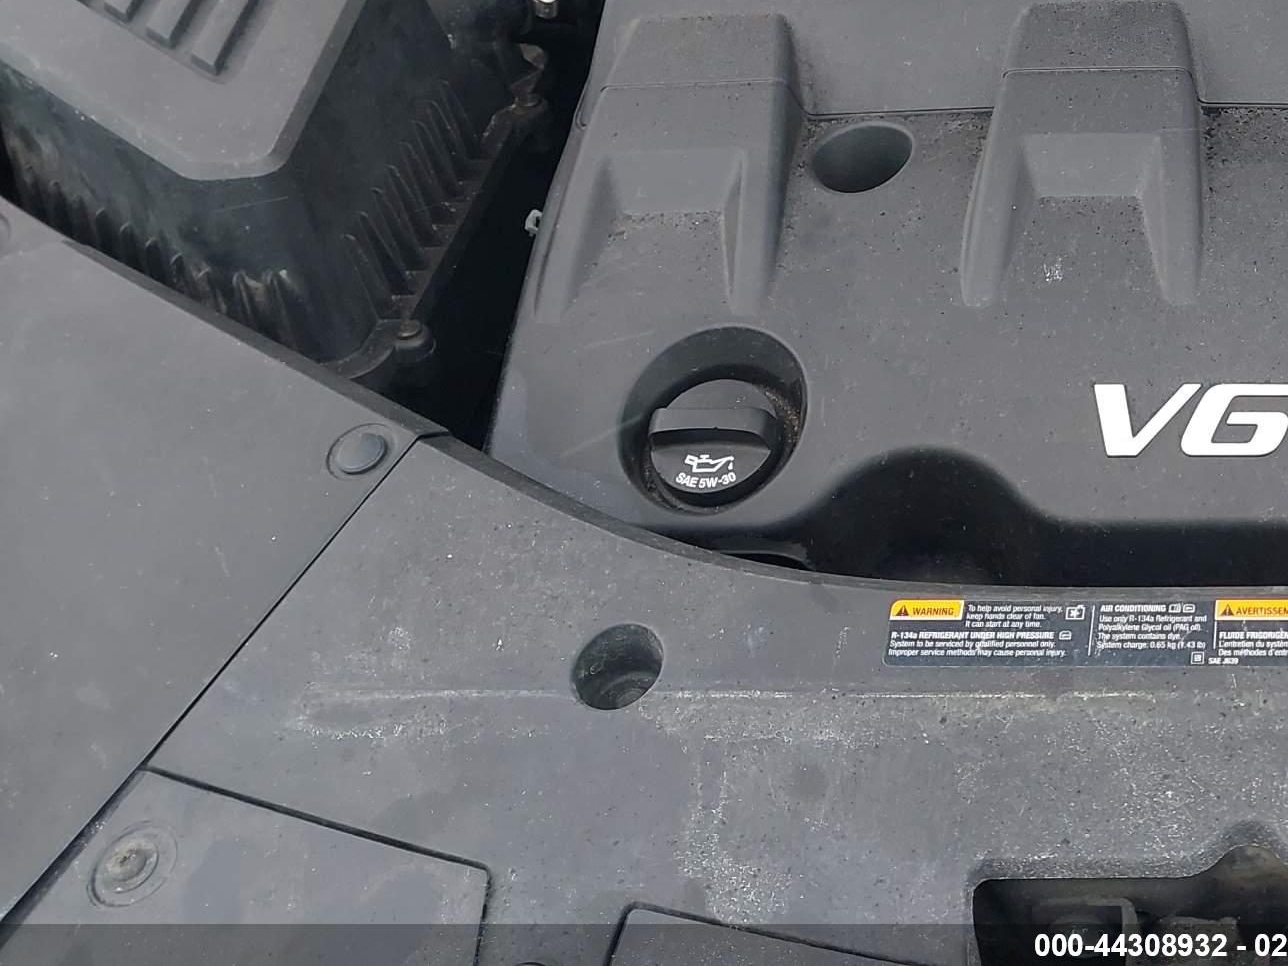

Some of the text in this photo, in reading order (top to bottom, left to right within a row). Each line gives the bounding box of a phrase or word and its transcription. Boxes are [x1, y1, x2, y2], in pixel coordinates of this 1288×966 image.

[676, 472, 736, 488] SAE 5W-30
[912, 607, 954, 615] WARNING
[968, 605, 1063, 613] To help avoid personal injury,
[1219, 631, 1244, 639] FLUIDE
[890, 640, 914, 648] System
[916, 640, 923, 648] to
[924, 640, 933, 648] be
[935, 640, 963, 648] serviced
[965, 640, 973, 648] by
[975, 640, 1003, 648] qualified
[1005, 640, 1038, 648] personnel
[889, 649, 918, 657] Improper
[920, 649, 945, 657] service
[947, 649, 975, 657] methods
[977, 649, 992, 657] may
[994, 649, 1013, 657] cause
[1015, 649, 1045, 657] personal
[1219, 649, 1231, 657] Des
